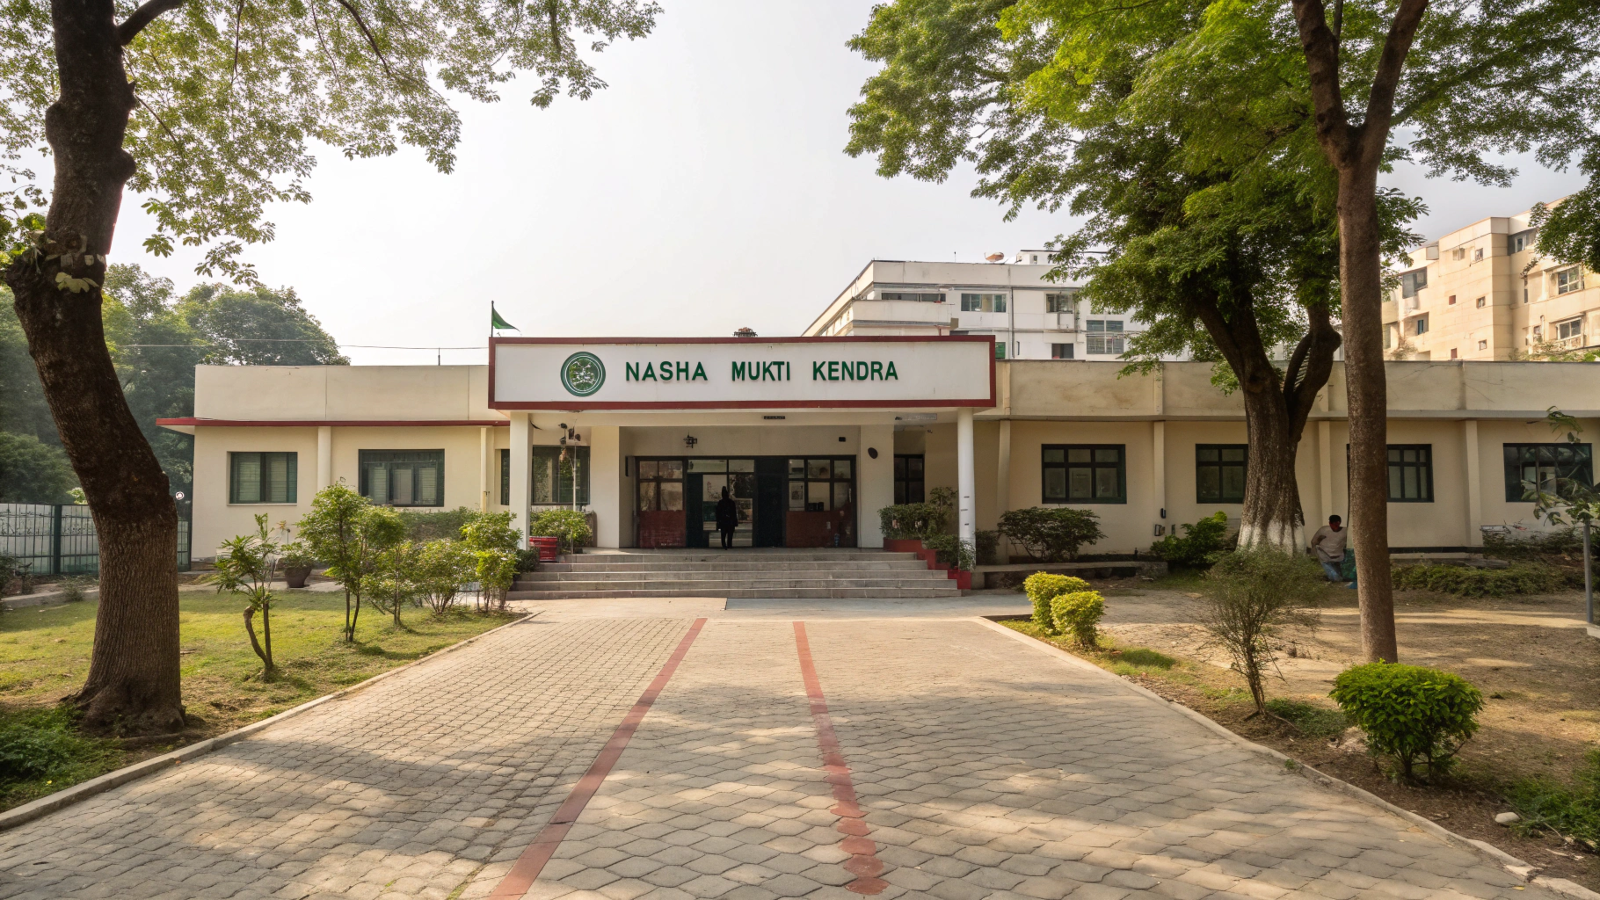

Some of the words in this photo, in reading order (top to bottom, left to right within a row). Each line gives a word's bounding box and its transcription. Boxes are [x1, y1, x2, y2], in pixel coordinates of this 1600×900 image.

[625, 360, 708, 382] NASHA
[731, 360, 791, 382] MUKTI
[812, 360, 899, 381] KENDRA
